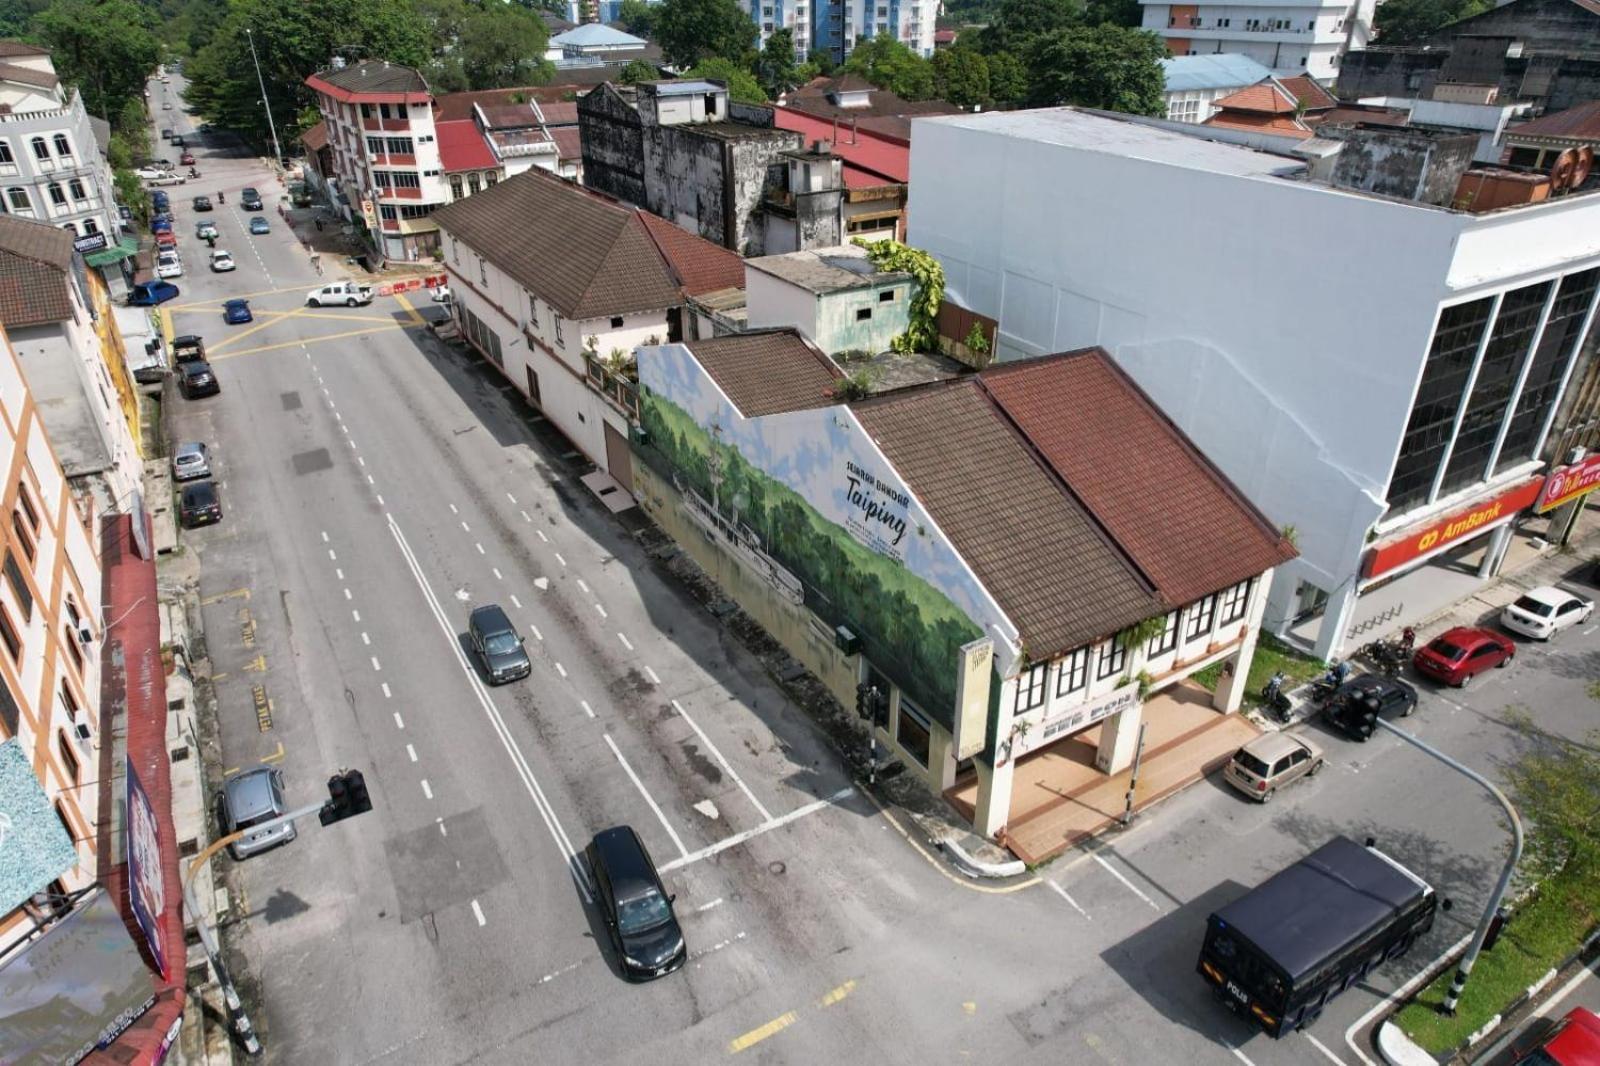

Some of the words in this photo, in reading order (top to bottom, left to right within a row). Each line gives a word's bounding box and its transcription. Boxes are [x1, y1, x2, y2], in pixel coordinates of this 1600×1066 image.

[847, 461, 875, 485] SEJARAH
[876, 480, 910, 509] BANDAR
[847, 475, 906, 546] Taiping
[1440, 502, 1502, 542] AmBank
[1227, 980, 1248, 1003] POLIS
